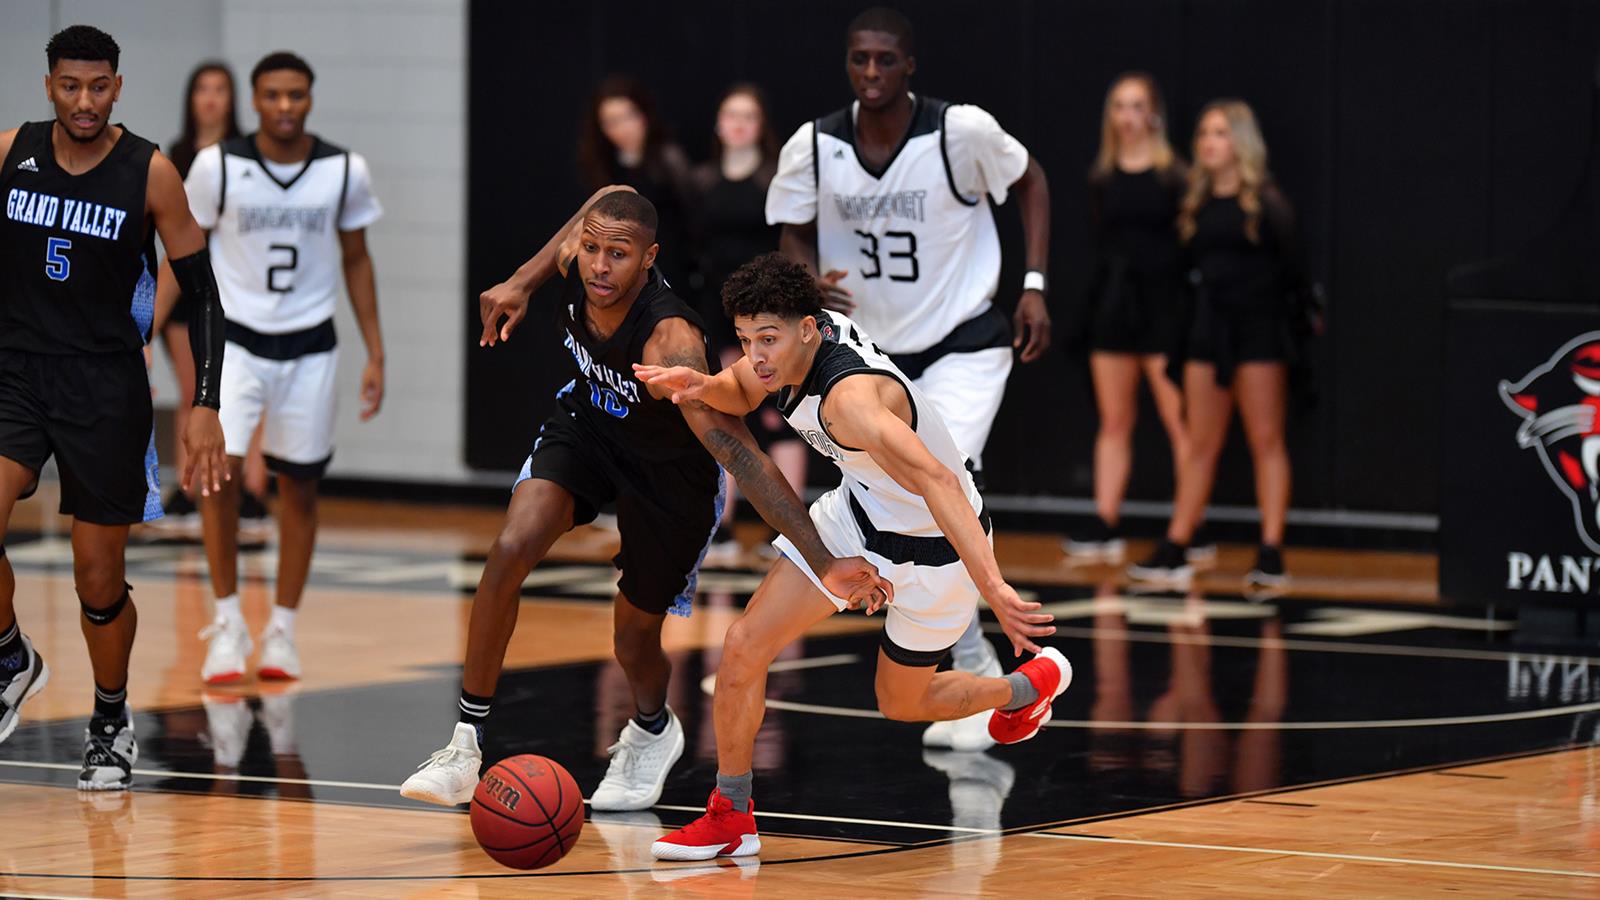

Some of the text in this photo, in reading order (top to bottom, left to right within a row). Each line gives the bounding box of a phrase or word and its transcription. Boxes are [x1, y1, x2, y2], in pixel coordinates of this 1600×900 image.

[6, 188, 127, 241] GRAND VALLEY
[45, 236, 72, 282] 5
[267, 244, 299, 294] 2
[854, 229, 919, 283] 33
[587, 379, 629, 419] 10
